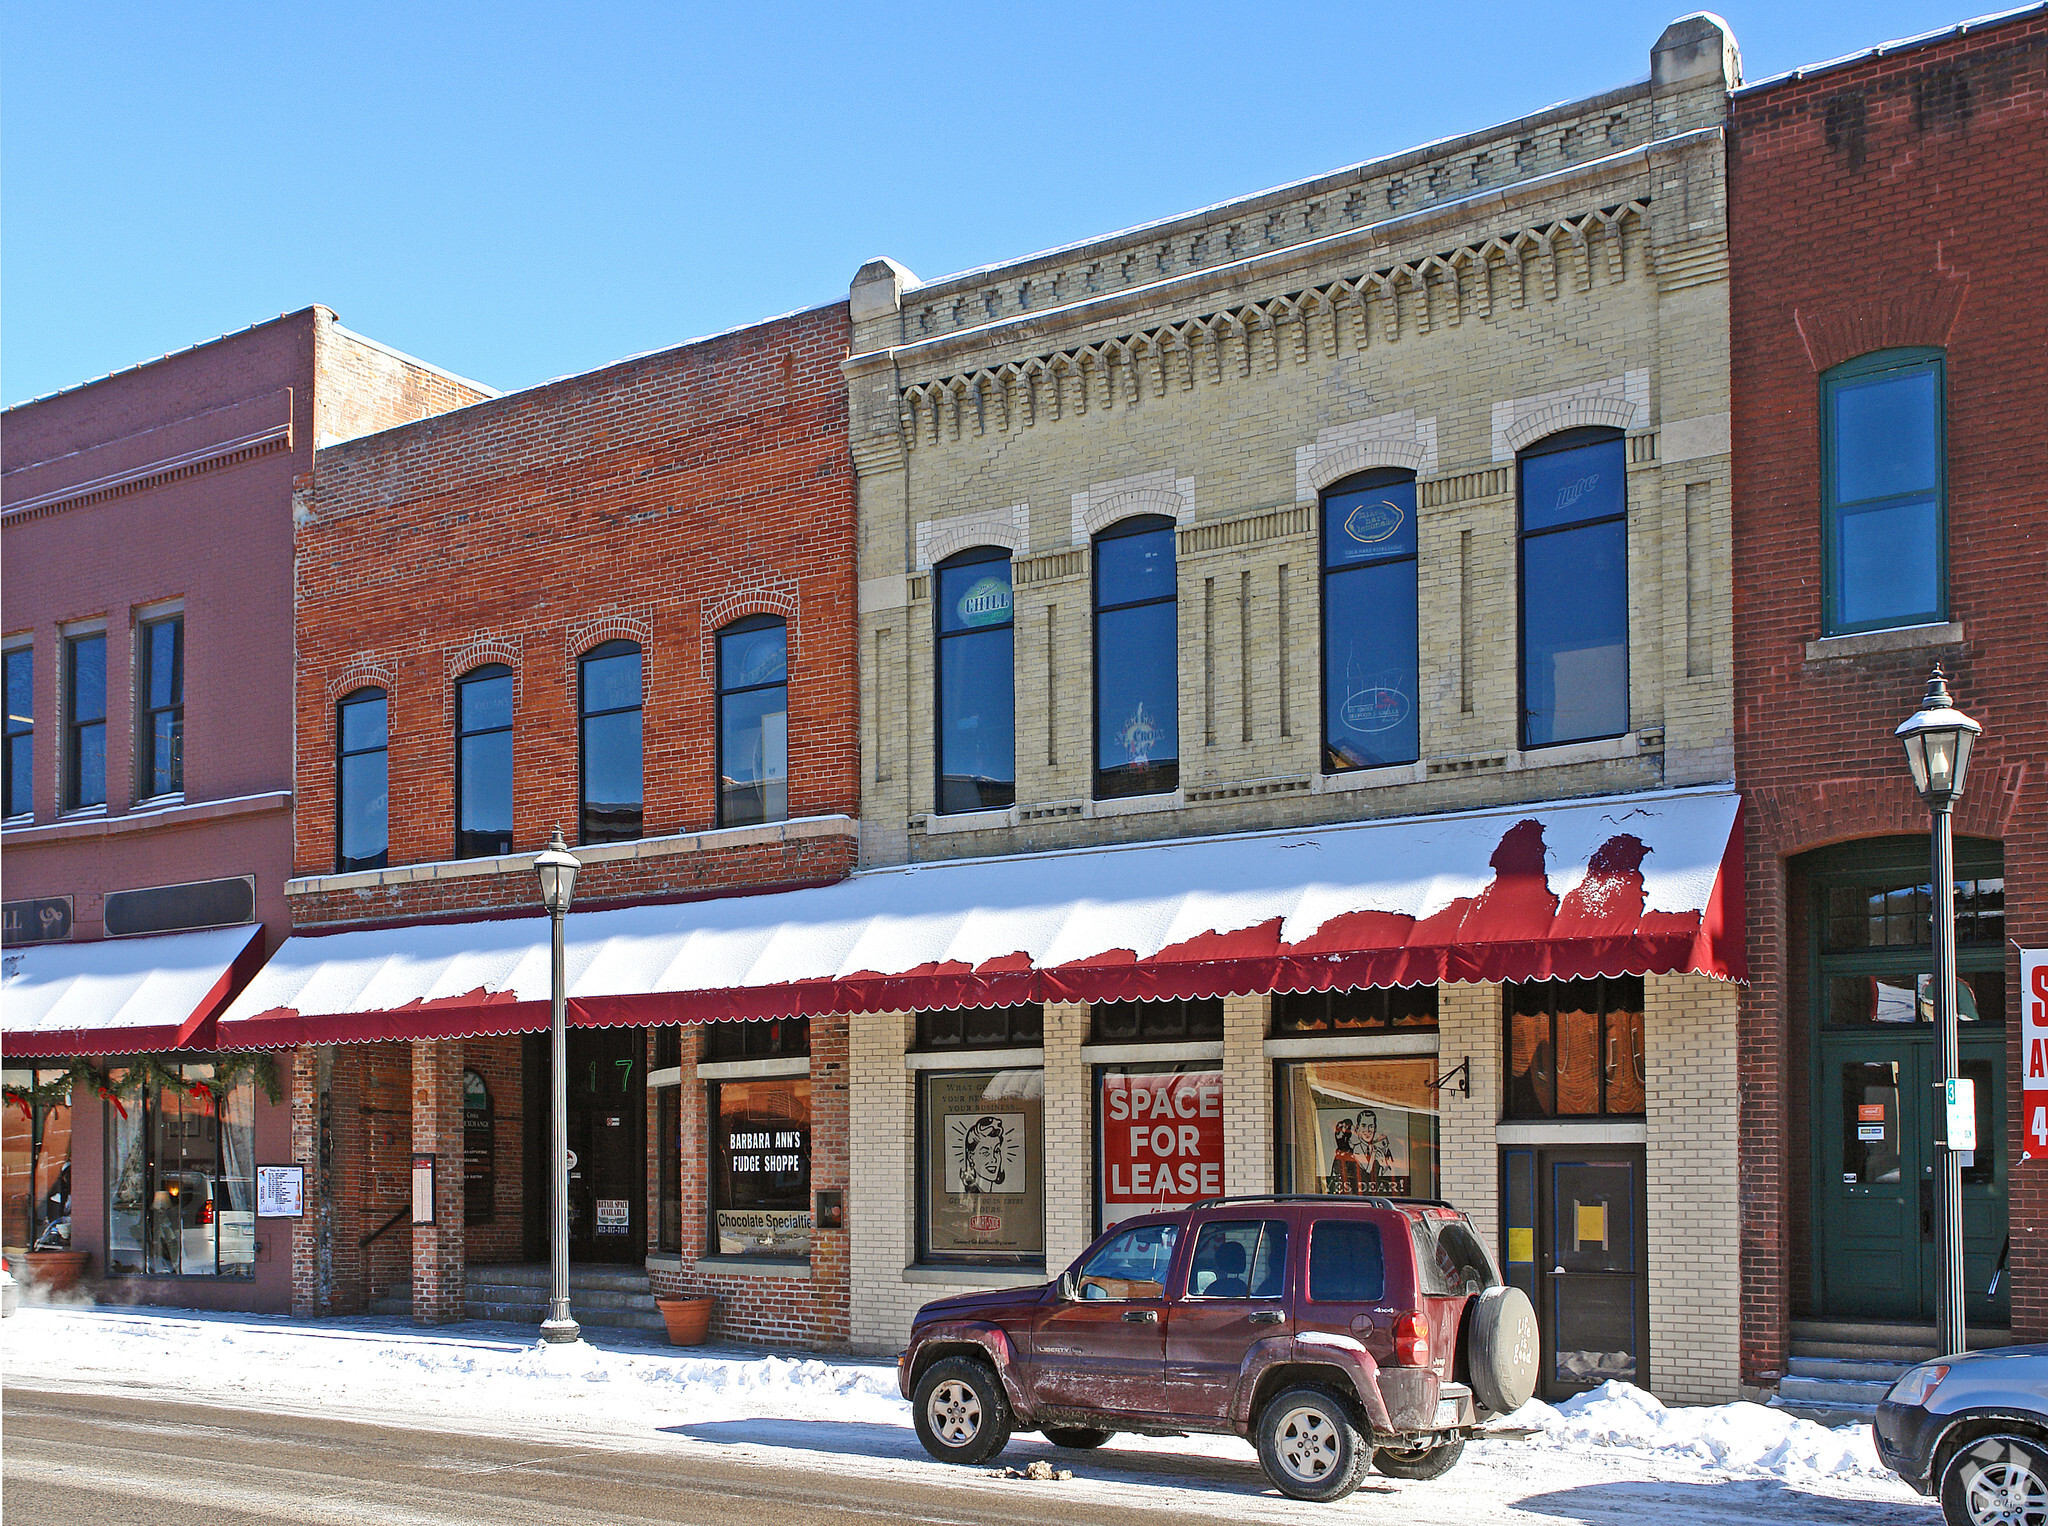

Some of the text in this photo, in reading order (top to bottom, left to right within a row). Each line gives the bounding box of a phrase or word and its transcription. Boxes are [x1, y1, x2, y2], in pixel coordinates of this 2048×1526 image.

[965, 592, 1010, 614] CHILL
[948, 1104, 971, 1112] YOUR
[1110, 1086, 1220, 1121] SPACE
[730, 1131, 801, 1150] BARBARA ANN'S
[1130, 1125, 1200, 1157] FOR
[733, 1154, 799, 1172] FUDGE SHOPPE
[1112, 1162, 1221, 1195] LEASE
[1357, 1179, 1405, 1193] DEAR!
[718, 1213, 764, 1228] Chocolate
